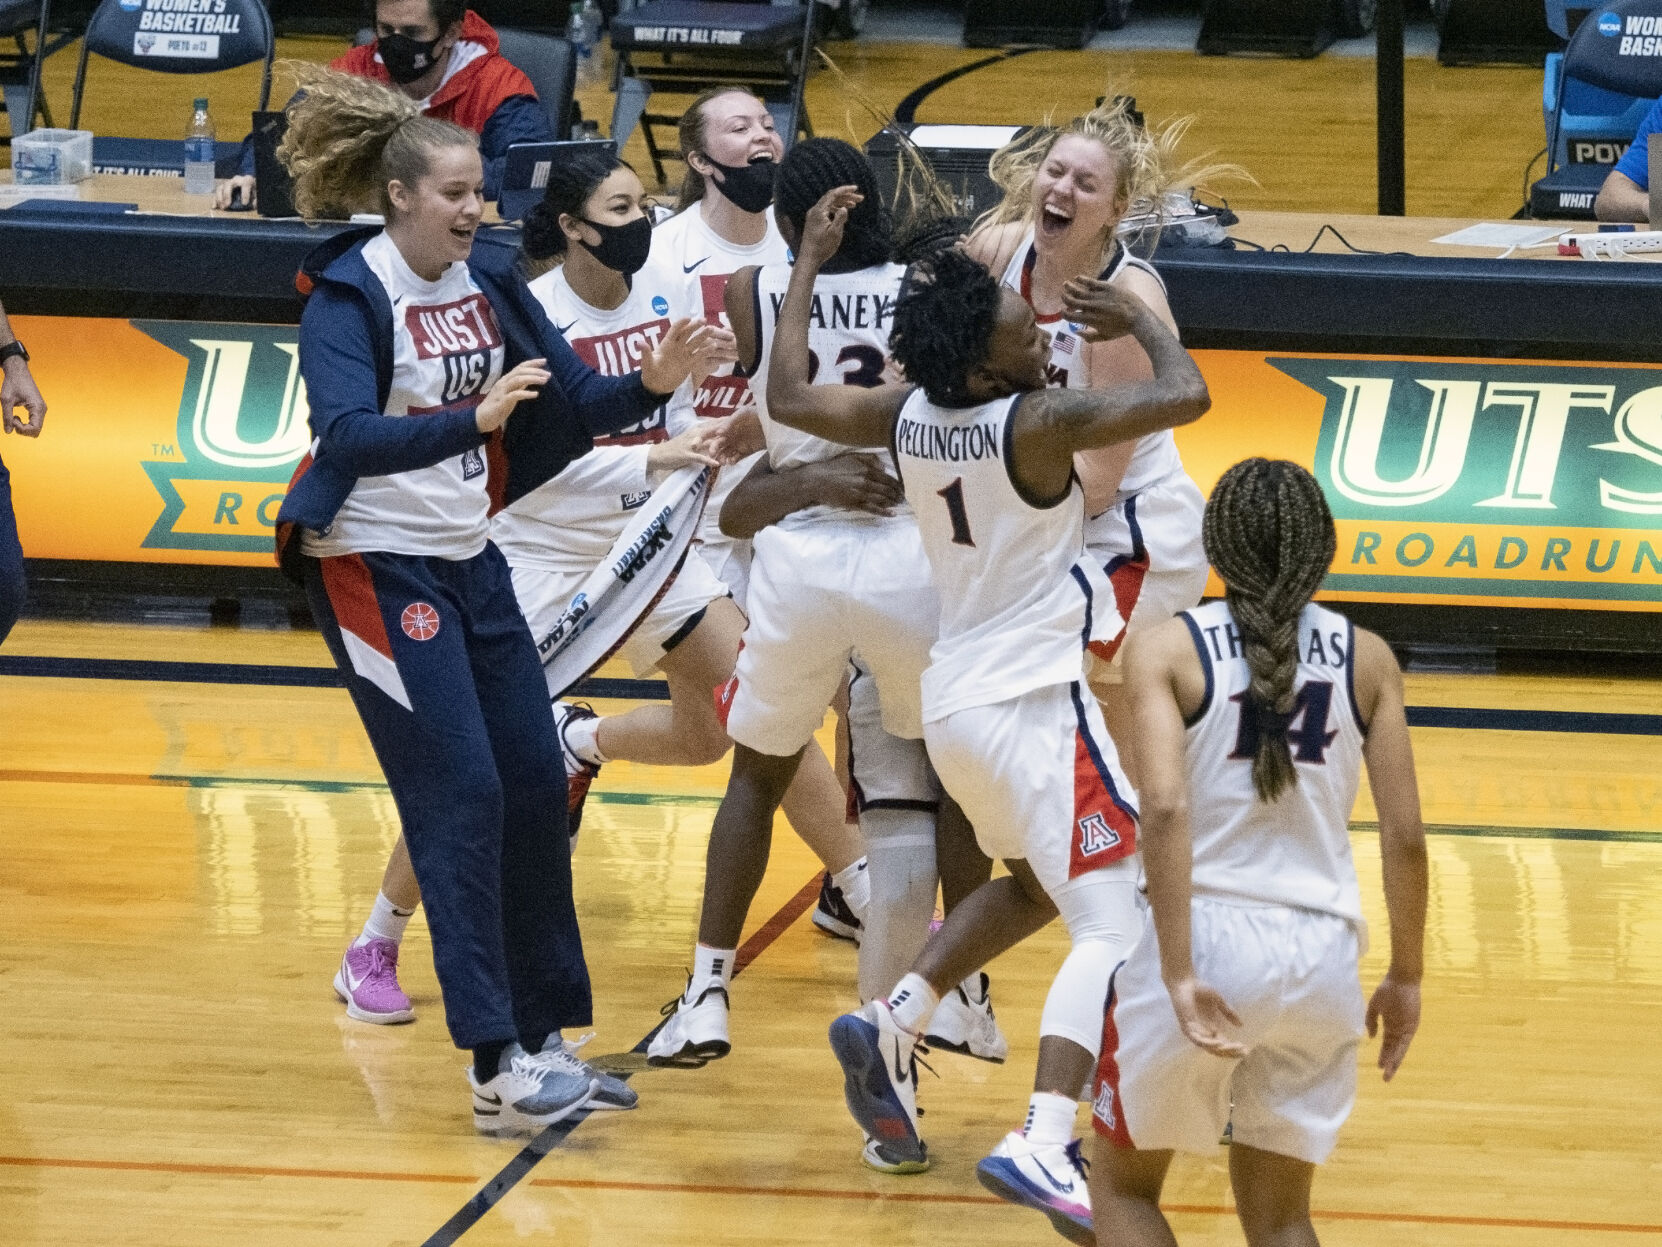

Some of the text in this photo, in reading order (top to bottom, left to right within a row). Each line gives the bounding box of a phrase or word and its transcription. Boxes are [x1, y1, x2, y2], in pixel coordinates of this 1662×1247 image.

[139, 11, 240, 33] BASKETBALL
[633, 26, 666, 42] WHAT
[666, 27, 690, 43] IT'S
[689, 28, 709, 43] ALL
[1559, 192, 1593, 209] WHAT
[419, 299, 493, 355] JUST
[769, 292, 889, 331] YANEY
[447, 353, 486, 401] US
[808, 344, 886, 389] 3
[152, 443, 175, 457] TM
[898, 418, 999, 462] PELLINGTON
[936, 476, 977, 549] 1
[1203, 623, 1346, 669] THAS
[1078, 810, 1121, 857] A
